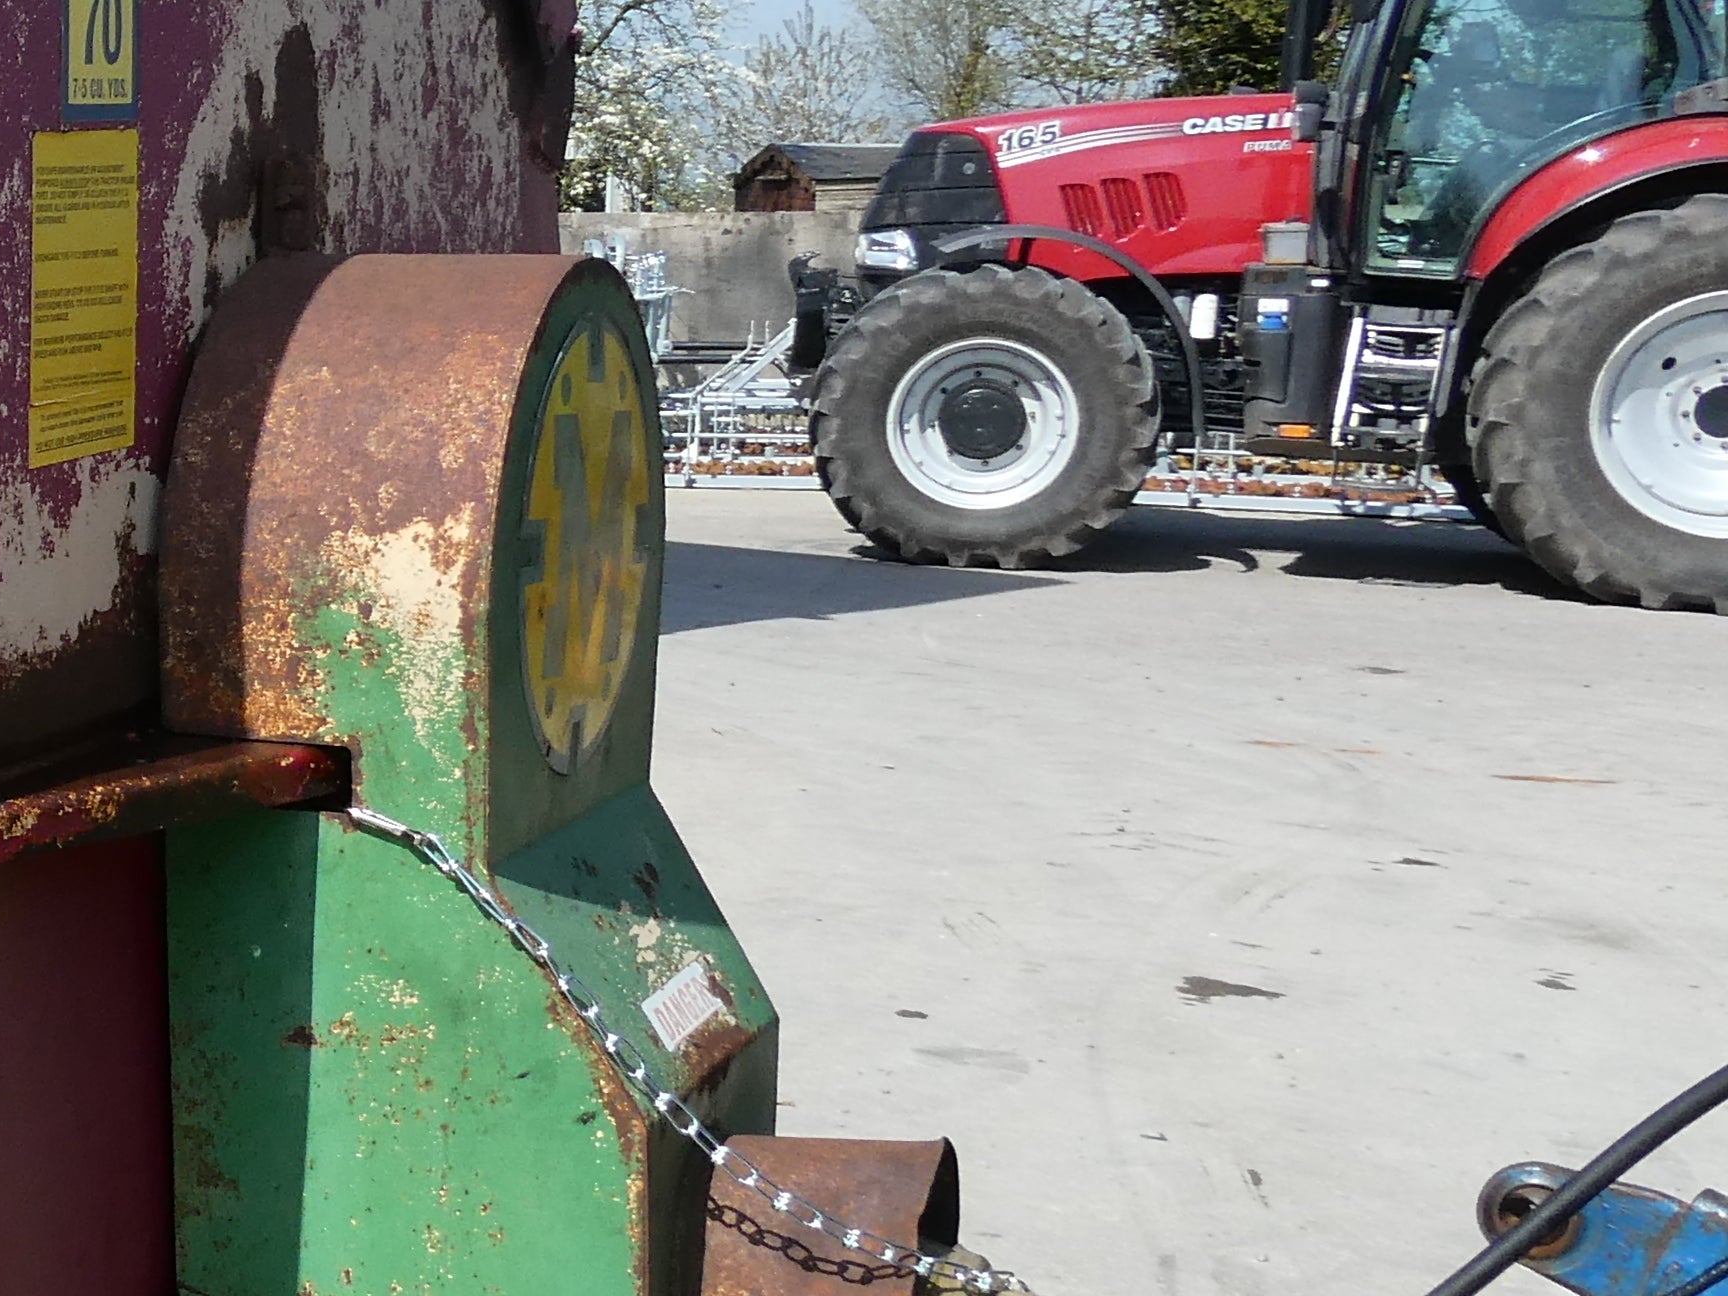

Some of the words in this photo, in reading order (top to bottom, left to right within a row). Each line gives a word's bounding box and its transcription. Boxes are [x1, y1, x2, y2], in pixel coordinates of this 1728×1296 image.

[998, 121, 1060, 153] 165
[1182, 114, 1265, 135] CASE
[1243, 140, 1292, 153] PUMA
[652, 975, 716, 1042] DANGER
